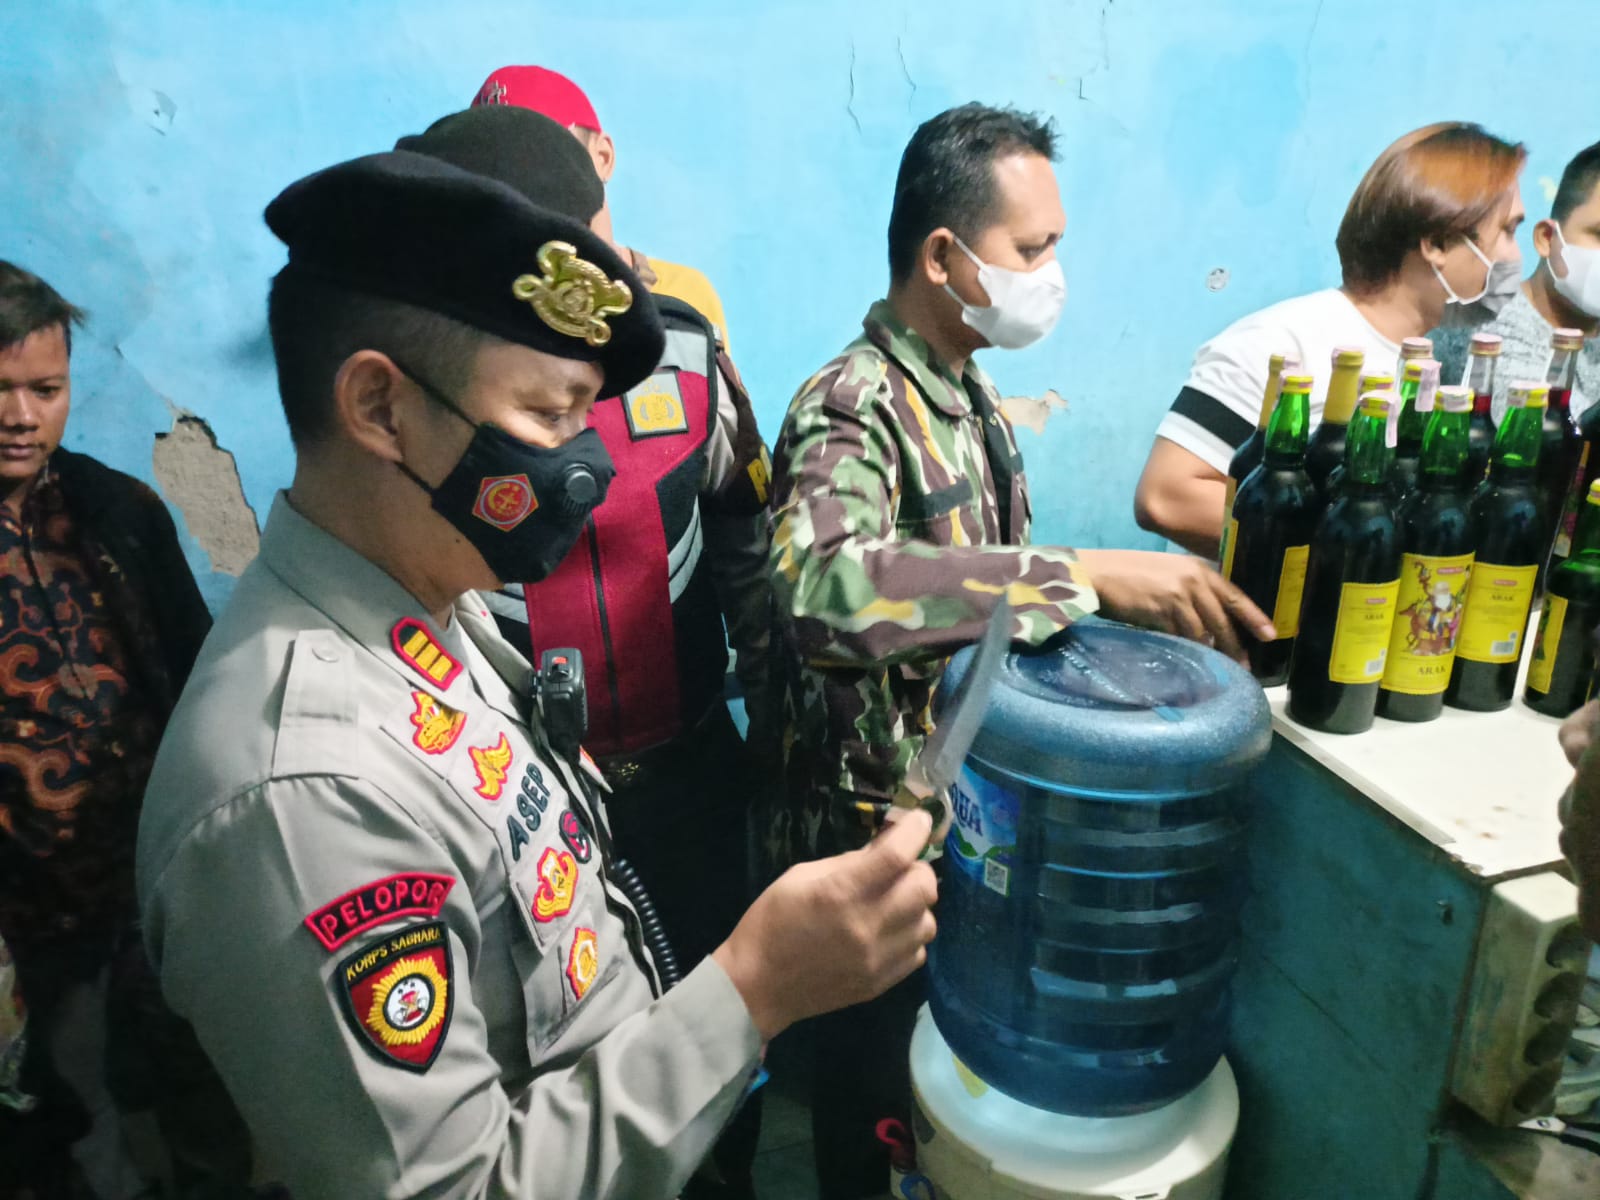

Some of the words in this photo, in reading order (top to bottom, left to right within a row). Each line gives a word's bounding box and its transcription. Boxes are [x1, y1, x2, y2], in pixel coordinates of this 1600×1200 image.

[507, 763, 551, 863] ASEP
[951, 782, 983, 837] QUA
[320, 879, 445, 942] PELOPOR
[346, 944, 388, 981] KORPS
